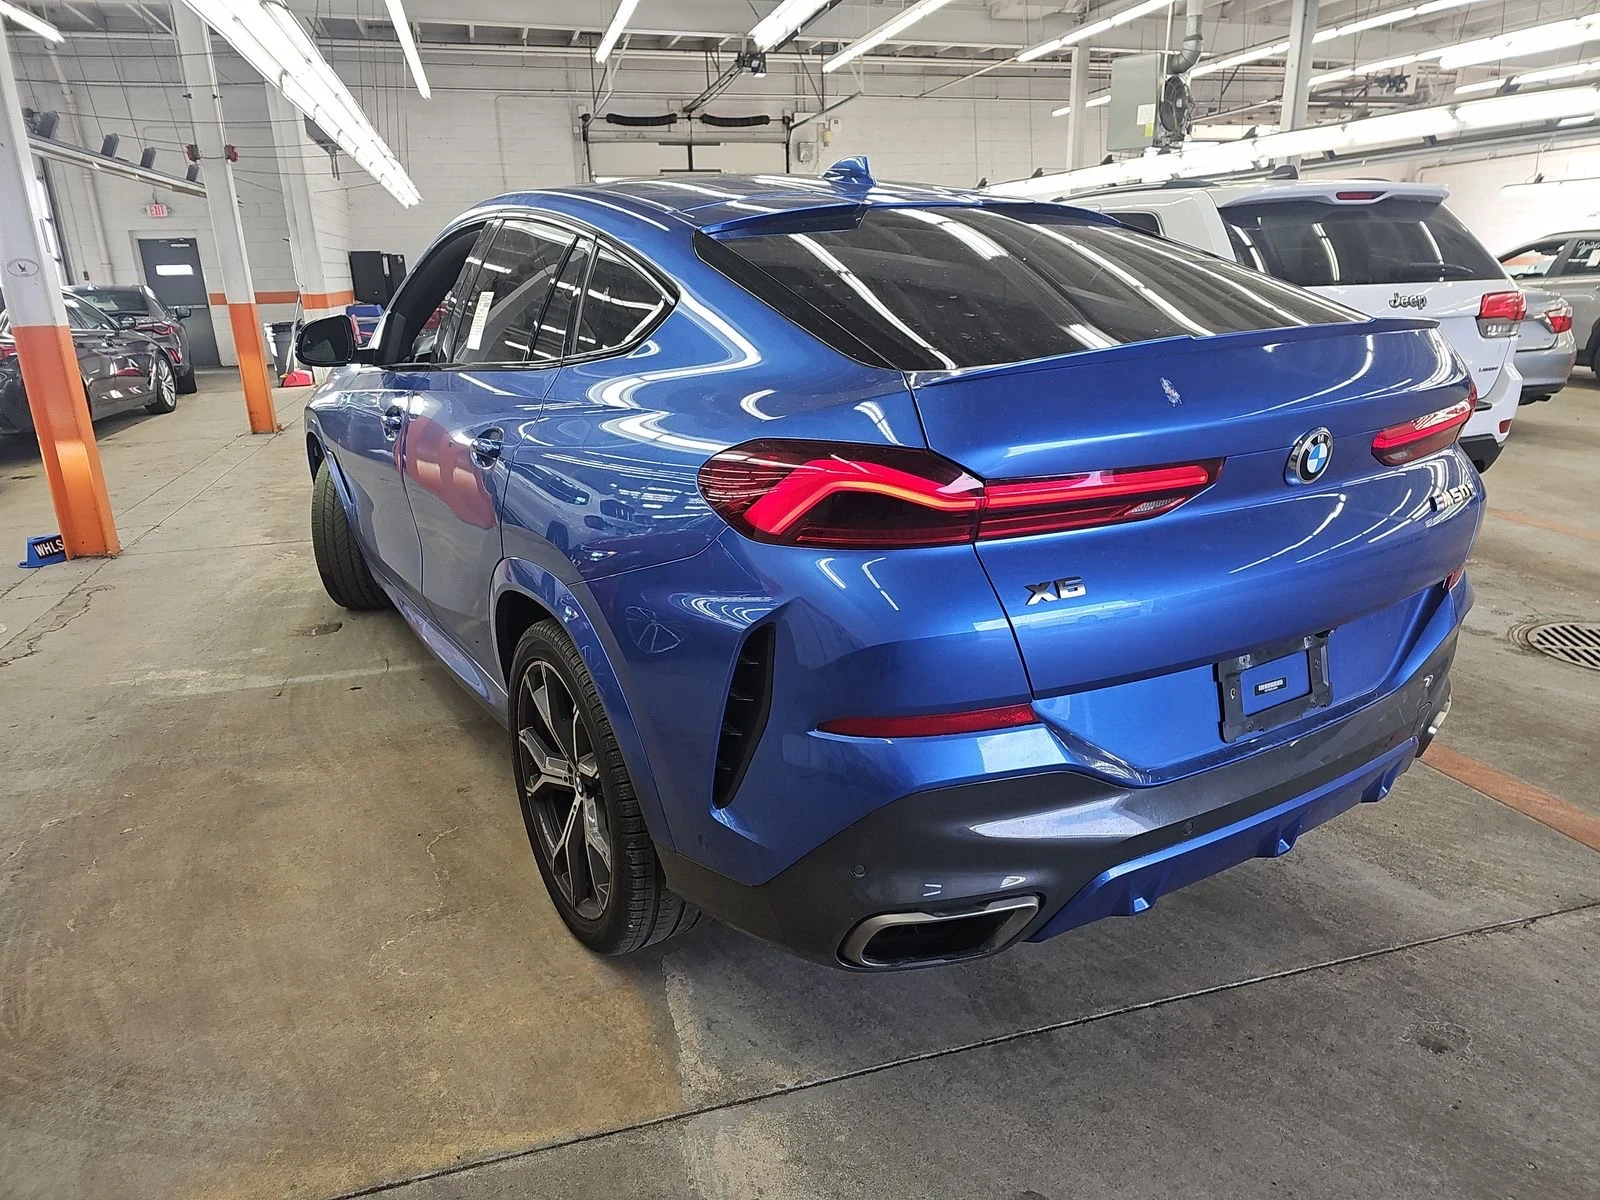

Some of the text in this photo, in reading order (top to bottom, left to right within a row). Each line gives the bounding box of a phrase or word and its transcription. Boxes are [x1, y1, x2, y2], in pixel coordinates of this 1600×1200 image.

[1389, 292, 1427, 310] Jeep
[33, 539, 65, 557] WHLS
[1023, 576, 1087, 606] X6
